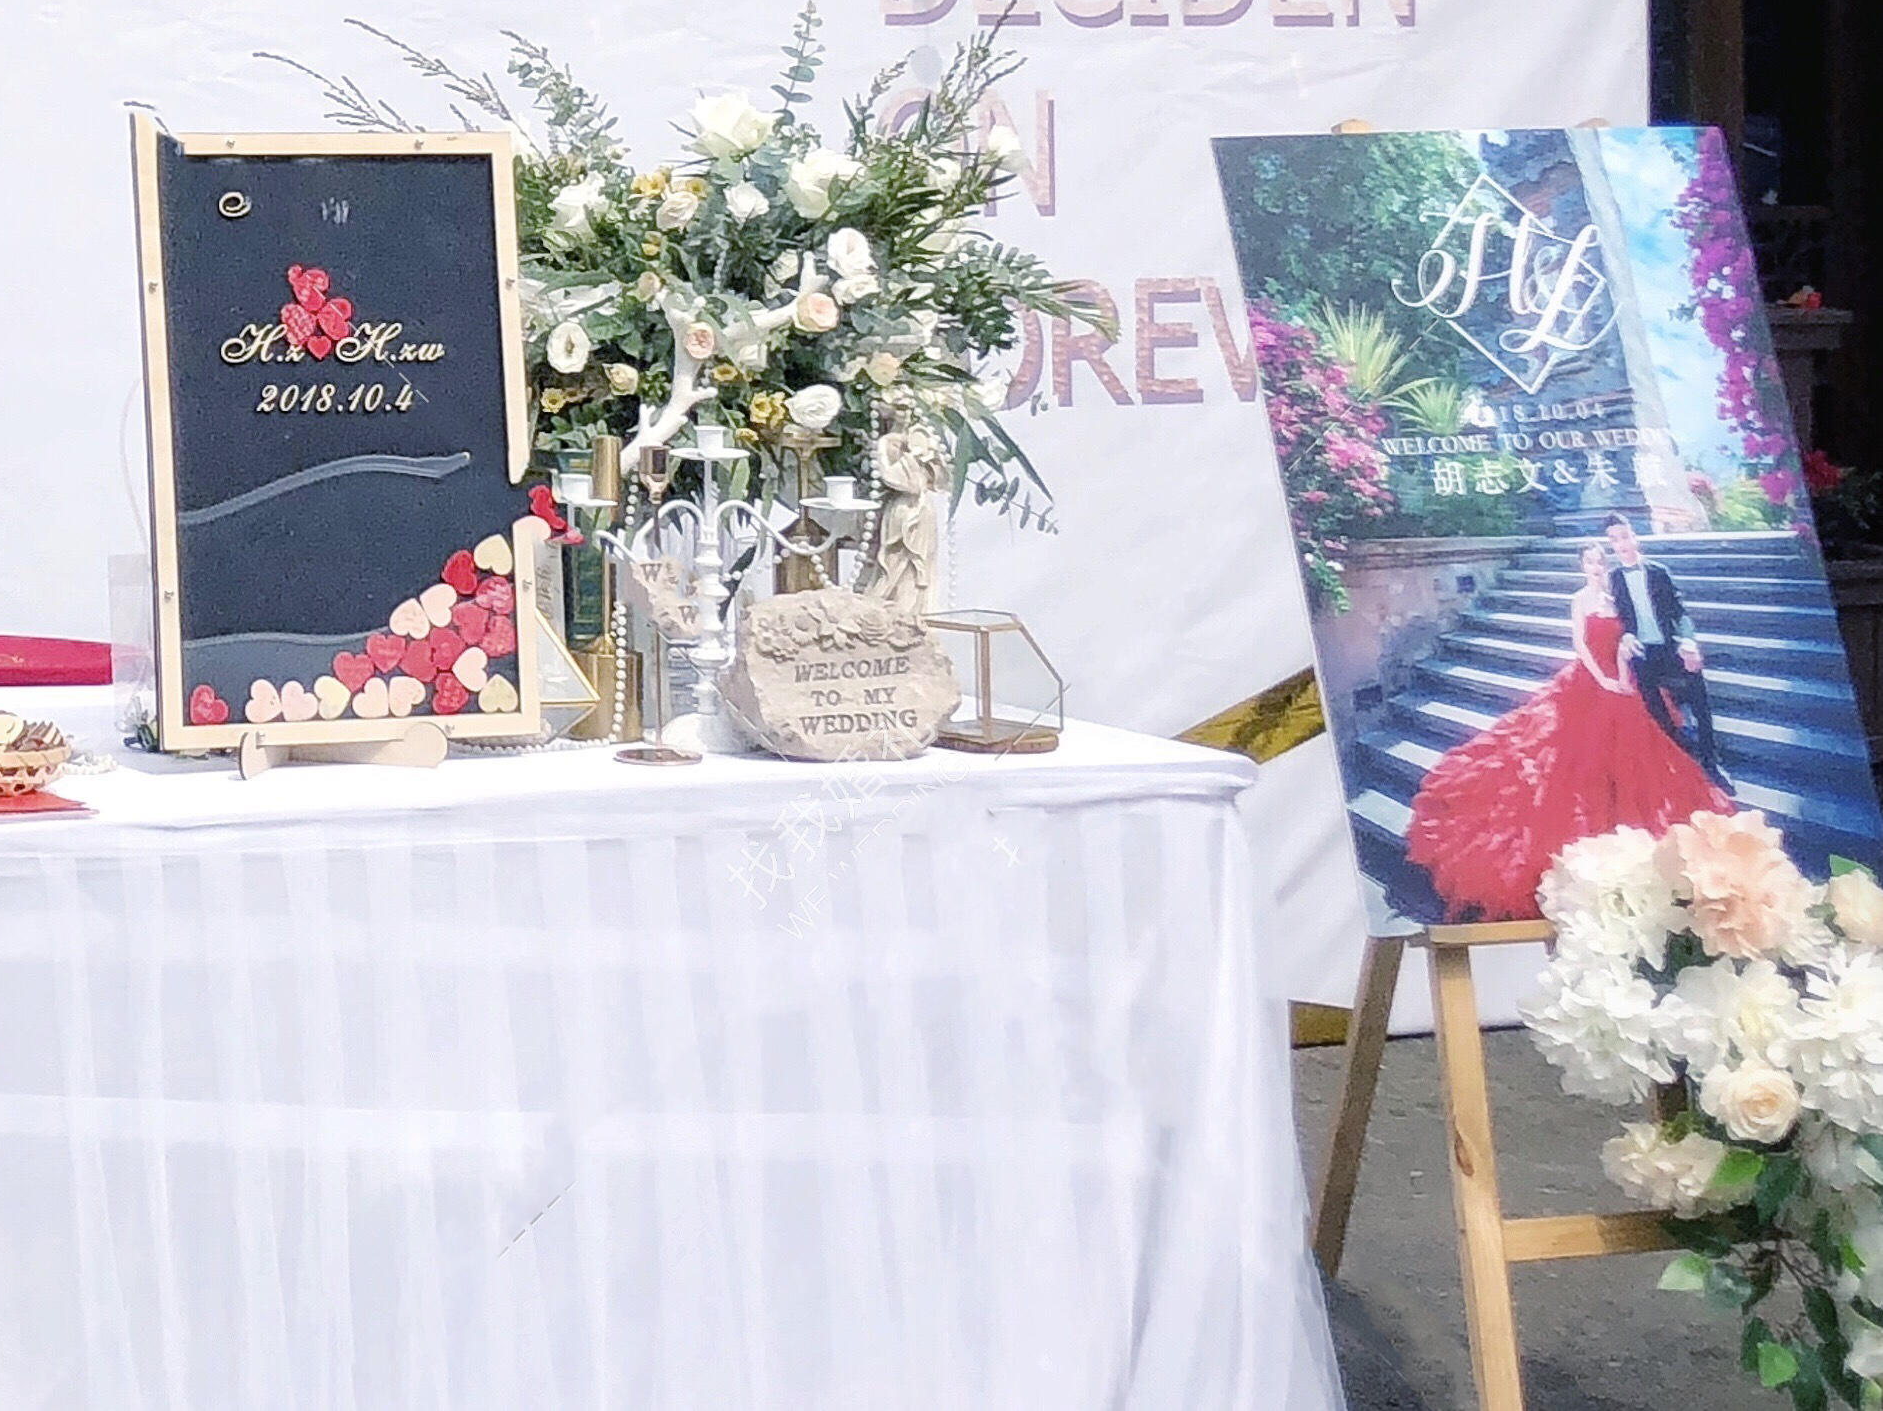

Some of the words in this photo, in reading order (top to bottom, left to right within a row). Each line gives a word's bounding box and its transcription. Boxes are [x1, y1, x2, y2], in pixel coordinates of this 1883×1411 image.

[255, 383, 414, 413] 2018.10.4
[1380, 433, 1489, 456] WELCOME
[1501, 432, 1531, 451] TO
[1538, 430, 1586, 450] OUR
[794, 655, 910, 684] WELCOME
[810, 689, 842, 707] TO
[864, 686, 898, 706] MY
[798, 708, 919, 737] WEDDING
